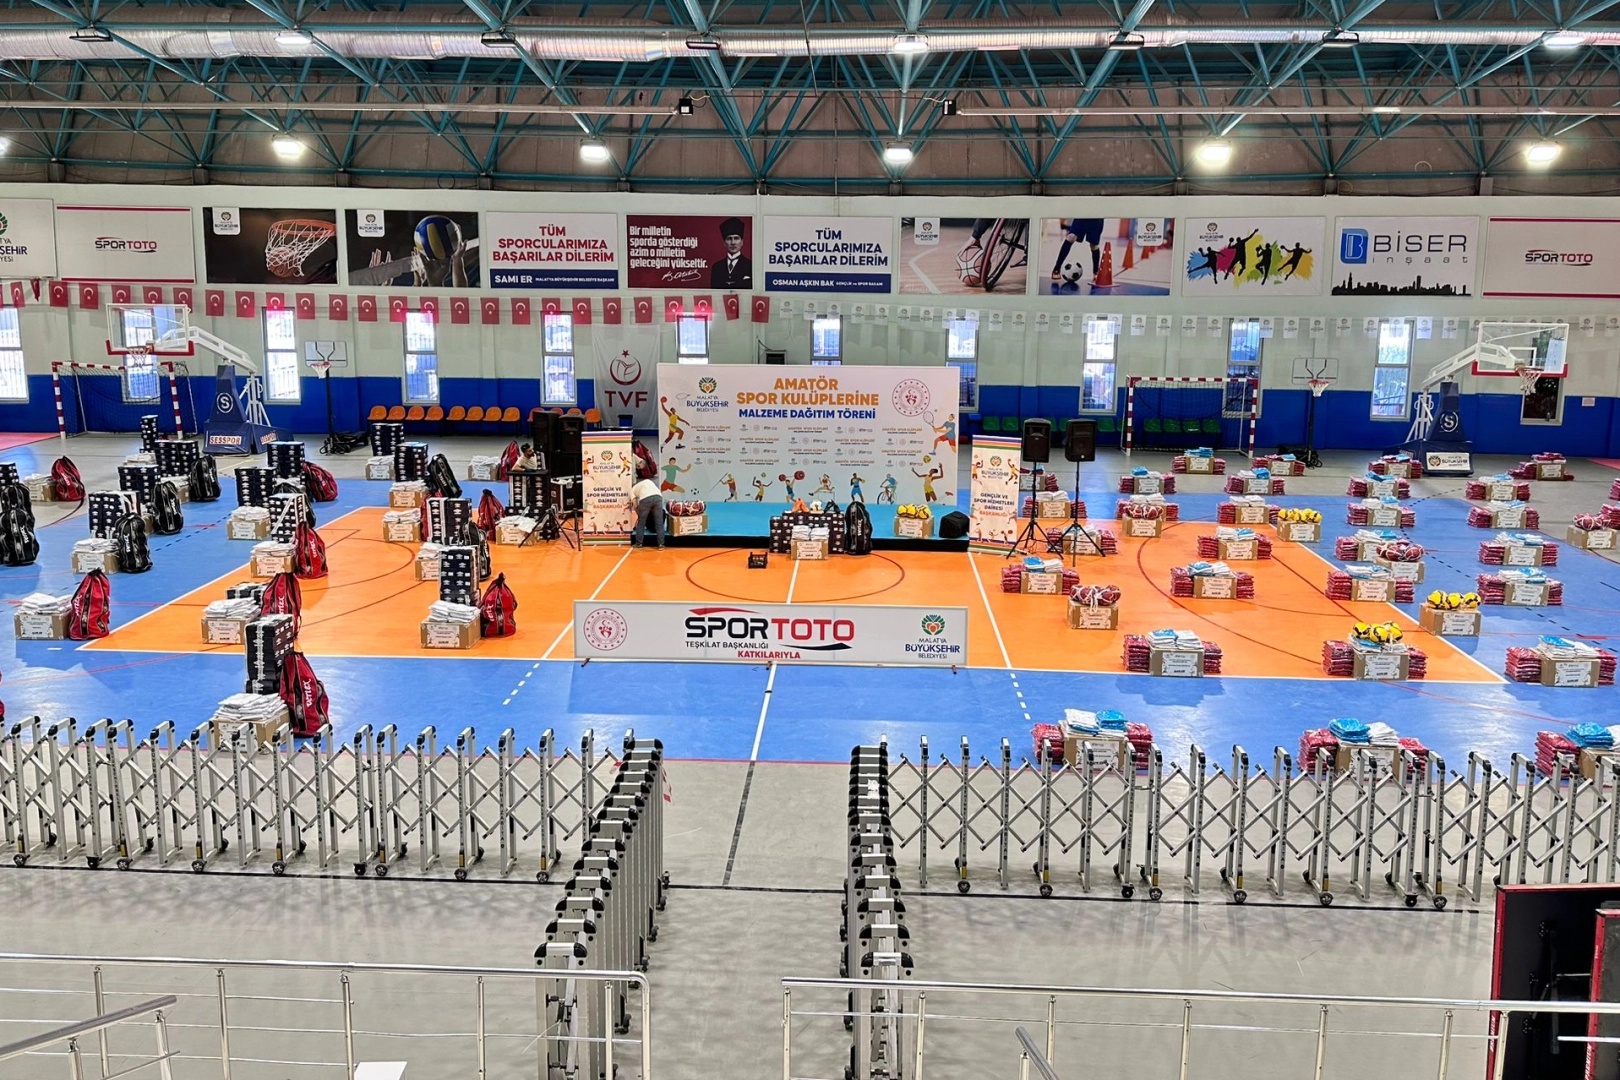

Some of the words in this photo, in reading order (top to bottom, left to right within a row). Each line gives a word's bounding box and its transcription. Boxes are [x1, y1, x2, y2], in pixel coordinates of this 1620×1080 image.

[539, 224, 566, 236] TÜM
[630, 226, 640, 236] Bir
[642, 226, 672, 236] milletin
[815, 227, 842, 240] TÜM
[498, 238, 608, 250] SPORCULARIMIZA
[630, 237, 657, 248] sporda
[658, 237, 698, 248] gösterdiği
[1374, 230, 1467, 252] BİSER
[630, 247, 649, 256] azim
[650, 249, 655, 257] o
[656, 247, 686, 257] milletin
[774, 242, 882, 253] SPORCULARIMIZA
[492, 251, 562, 264] BAŞARILAR
[566, 250, 614, 262] DİLERİM
[768, 254, 838, 267] BAŞARILAR
[840, 254, 888, 266] DİLERİM
[1372, 256, 1468, 265] inşaat
[630, 258, 670, 269] geleceğini
[671, 258, 708, 270] yükseltir.
[520, 275, 533, 283] ER
[774, 376, 838, 390] AMATÖR
[604, 390, 648, 408] TVF
[736, 392, 778, 405] SPOR
[781, 390, 879, 406] KULÜPLERİNE
[738, 409, 788, 418] MALZEME
[790, 408, 834, 418] DAĞITIM
[839, 408, 876, 419] TÖRENİ
[722, 641, 768, 650] BAŞKANLIĞI
[905, 644, 960, 653] BÜYÜKŞEHİR
